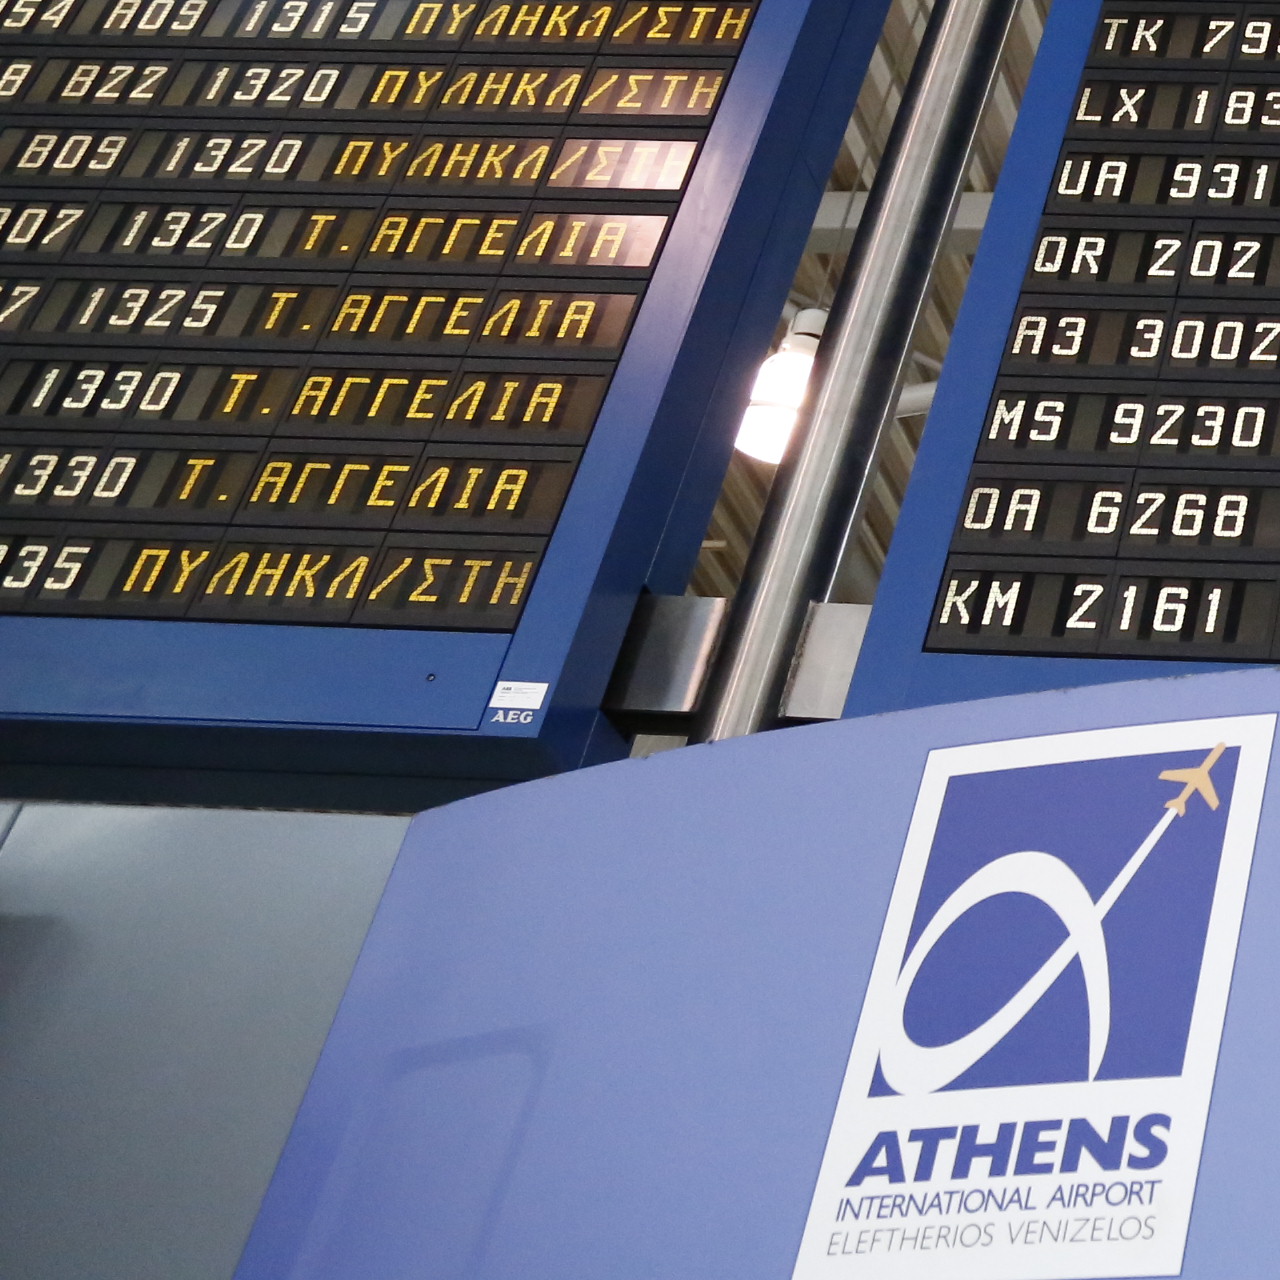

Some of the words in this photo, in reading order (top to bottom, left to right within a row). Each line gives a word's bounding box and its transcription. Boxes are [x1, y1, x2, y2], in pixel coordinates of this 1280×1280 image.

[104, 0, 207, 30] A09
[245, 1, 376, 33] 1315
[1104, 19, 1163, 51] TK
[62, 65, 168, 98] B22
[206, 68, 339, 101] 1320
[1012, 316, 1086, 355] A3
[964, 488, 1040, 530] OA
[1087, 491, 1248, 537] 6268
[940, 580, 1020, 625] KM
[1066, 584, 1221, 632] 2161
[491, 710, 534, 724] AEG
[844, 1113, 1172, 1187] ATHENS
[835, 1186, 1037, 1223] INTERNATIONAL
[1046, 1180, 1162, 1209] AIRPORT
[826, 1223, 996, 1256] ELEFTHERIOS
[1008, 1216, 1157, 1245] VENIZELOS
